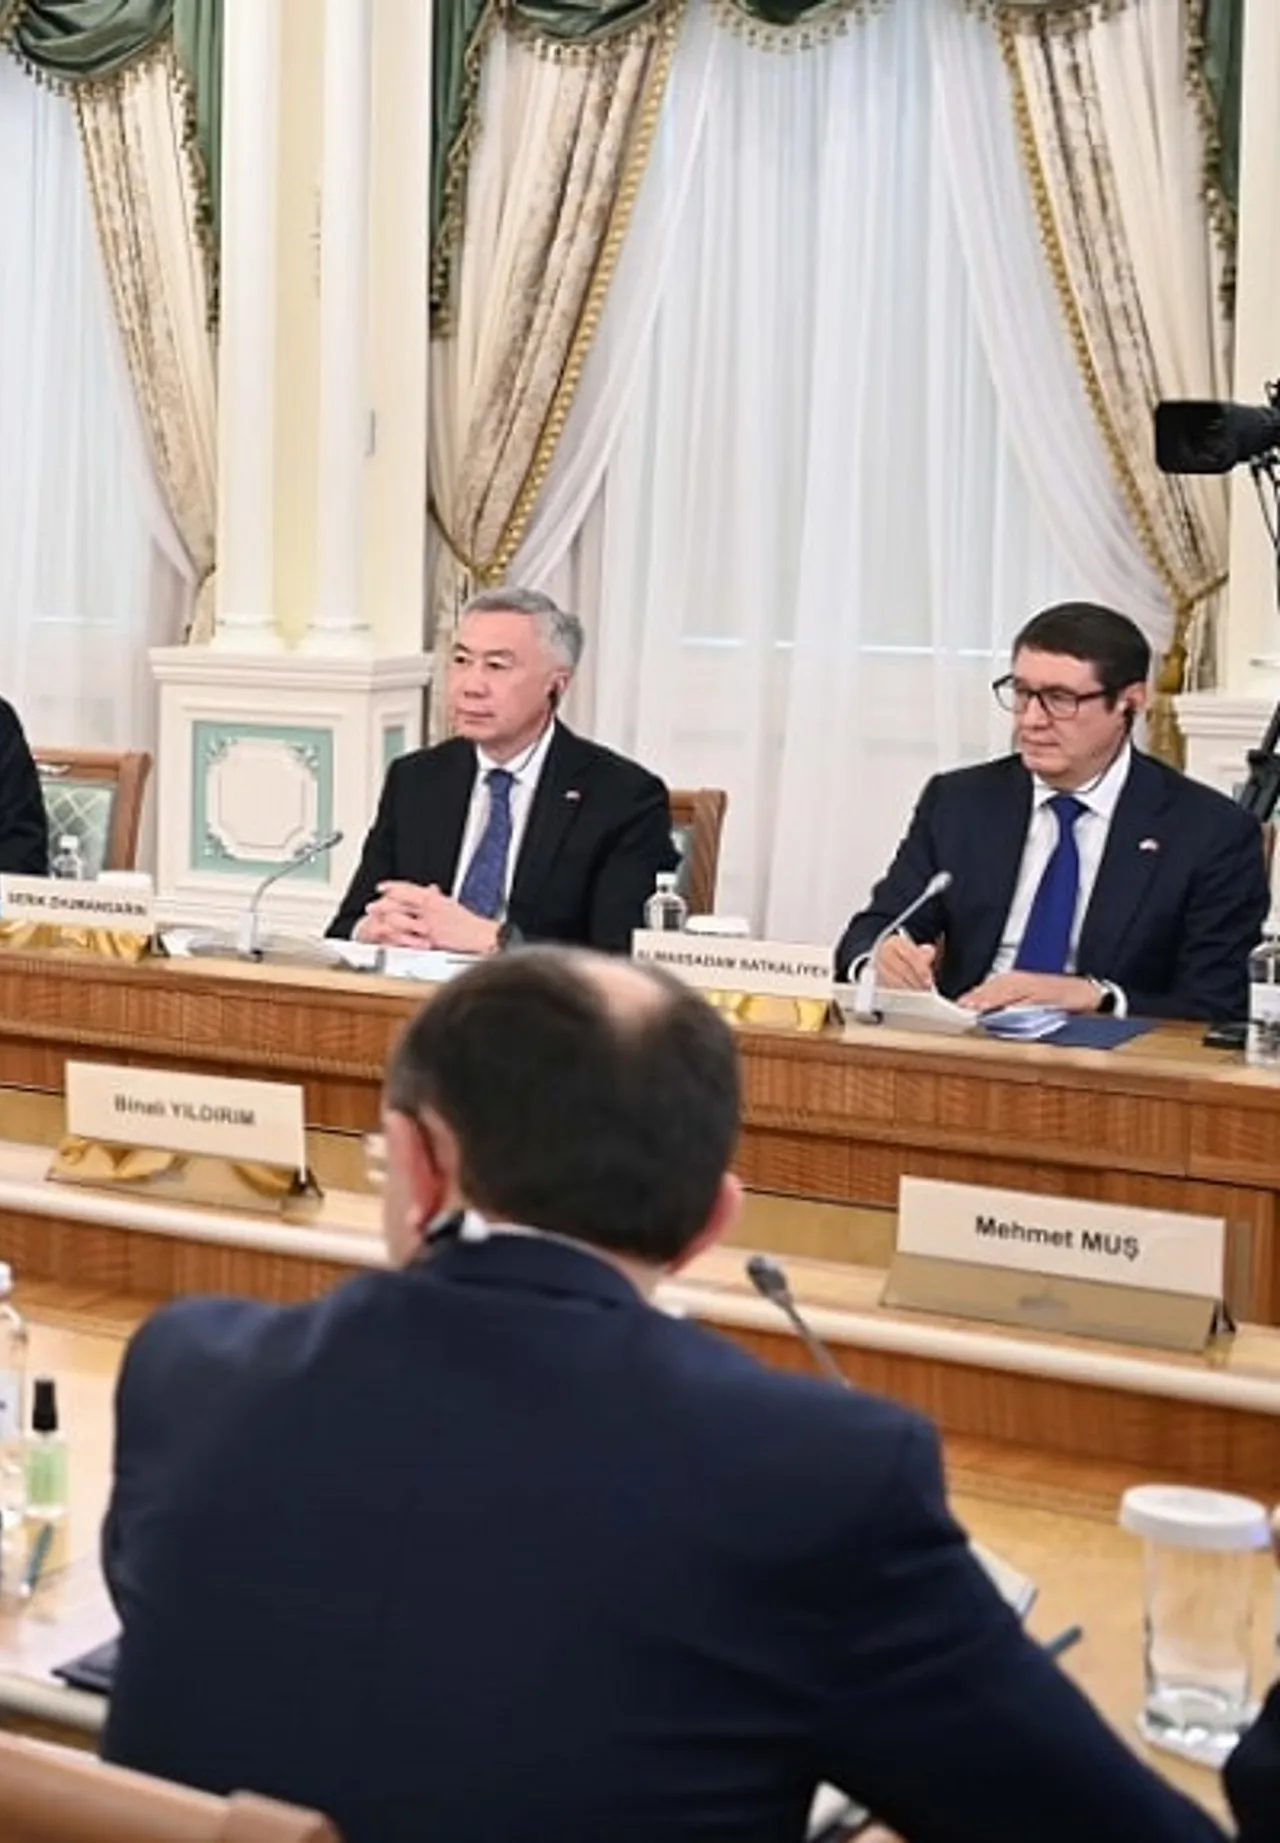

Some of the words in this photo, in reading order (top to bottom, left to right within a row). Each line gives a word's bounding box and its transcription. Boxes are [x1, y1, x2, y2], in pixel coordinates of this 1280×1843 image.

[113, 1094, 165, 1117] Binali
[975, 1215, 1074, 1250] Mehmet
[1081, 1231, 1141, 1263] MUŞ
